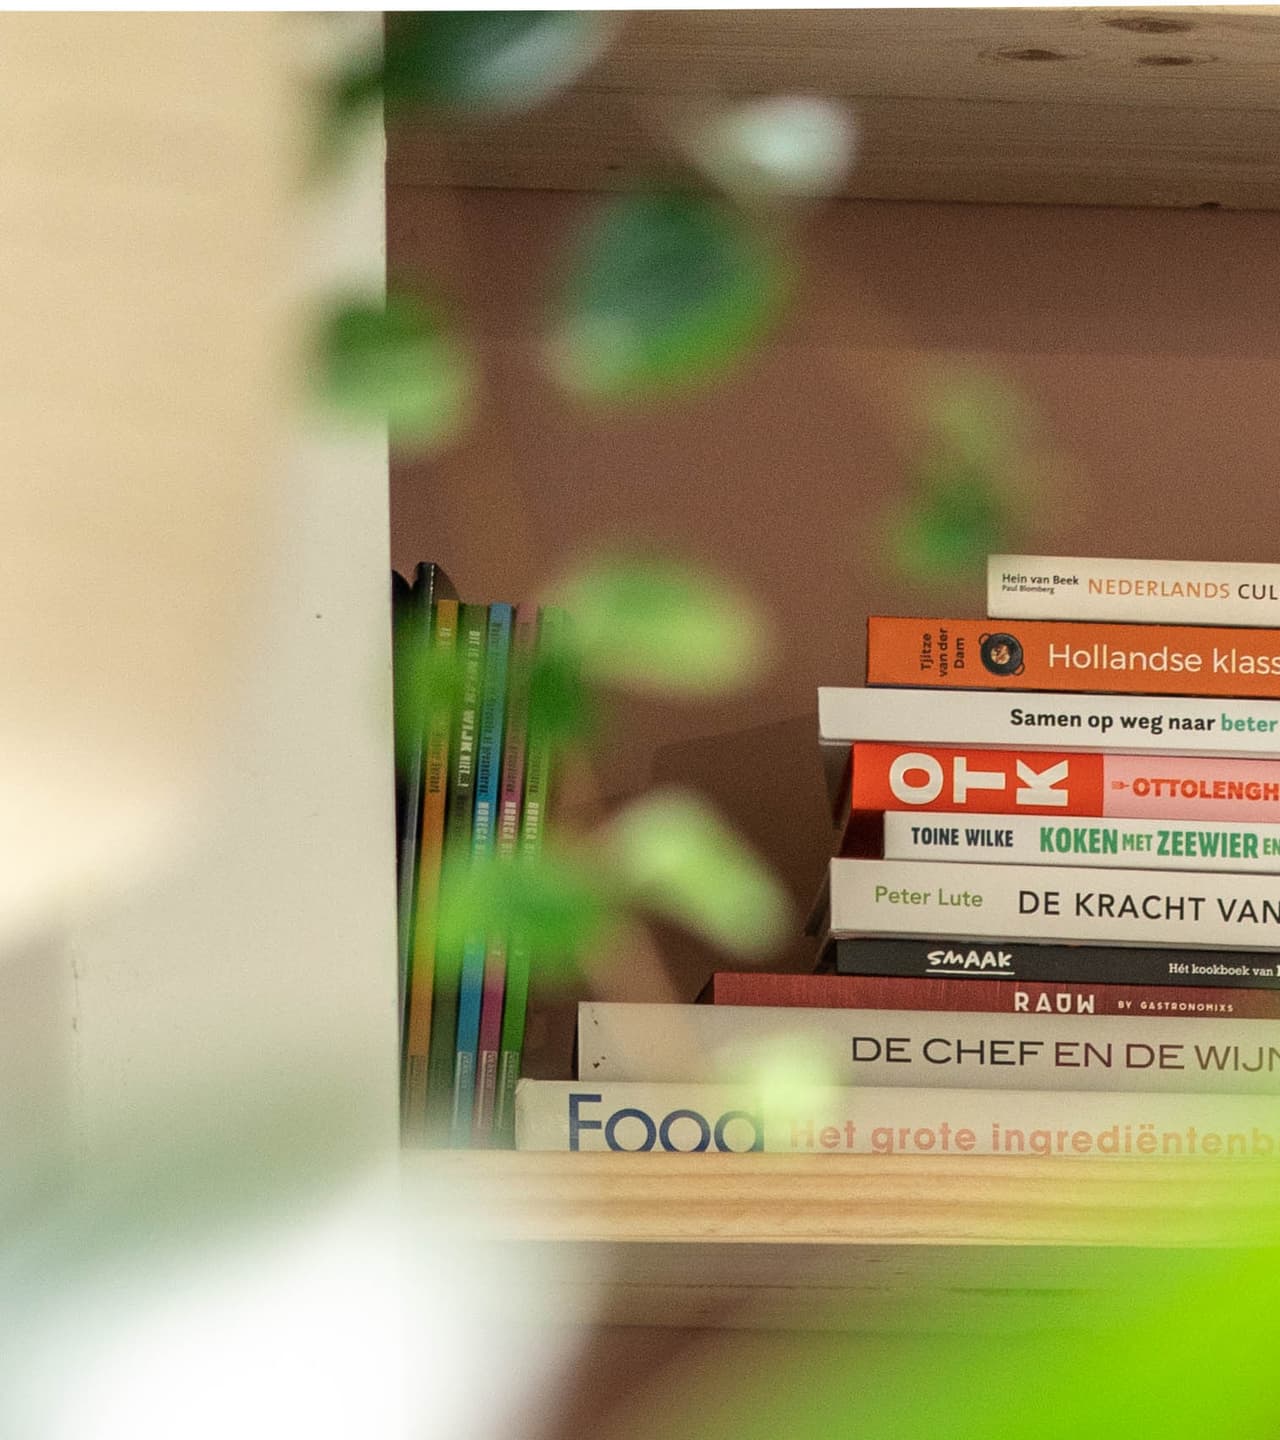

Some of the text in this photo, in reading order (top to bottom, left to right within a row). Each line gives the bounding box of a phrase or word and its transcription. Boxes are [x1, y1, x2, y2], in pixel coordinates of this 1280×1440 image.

[1002, 573, 1079, 587] Hein van Beek
[1088, 577, 1231, 599] NEDERLANDS
[920, 632, 933, 671] Tjitze
[938, 628, 948, 678] van der
[954, 637, 965, 669] Dam
[1048, 643, 1203, 673] Hollandse
[1010, 708, 1082, 729] Samen
[1087, 714, 1114, 734] op
[1119, 715, 1164, 735] weg
[1169, 715, 1216, 732] naar
[1221, 713, 1278, 733] beter
[911, 827, 1014, 848] TOINE WILKE
[1039, 827, 1119, 855] KOKEN
[1122, 833, 1154, 852] MET
[1156, 829, 1259, 859] ZEEWIER
[875, 885, 984, 908] Peter Lute
[1018, 890, 1061, 916] DE
[1075, 892, 1206, 921] KRACHT
[926, 949, 1014, 969] SMAAK
[1191, 963, 1250, 977] kookboek
[1252, 968, 1274, 978] van
[1117, 1000, 1235, 1013] BY GASTRONOMIXS
[852, 1036, 912, 1064] DE
[922, 1038, 1045, 1066] CHEF
[1054, 1042, 1113, 1068] EN
[1125, 1044, 1186, 1070] DE
[789, 1119, 857, 1149] Het
[870, 1121, 977, 1155] grote
